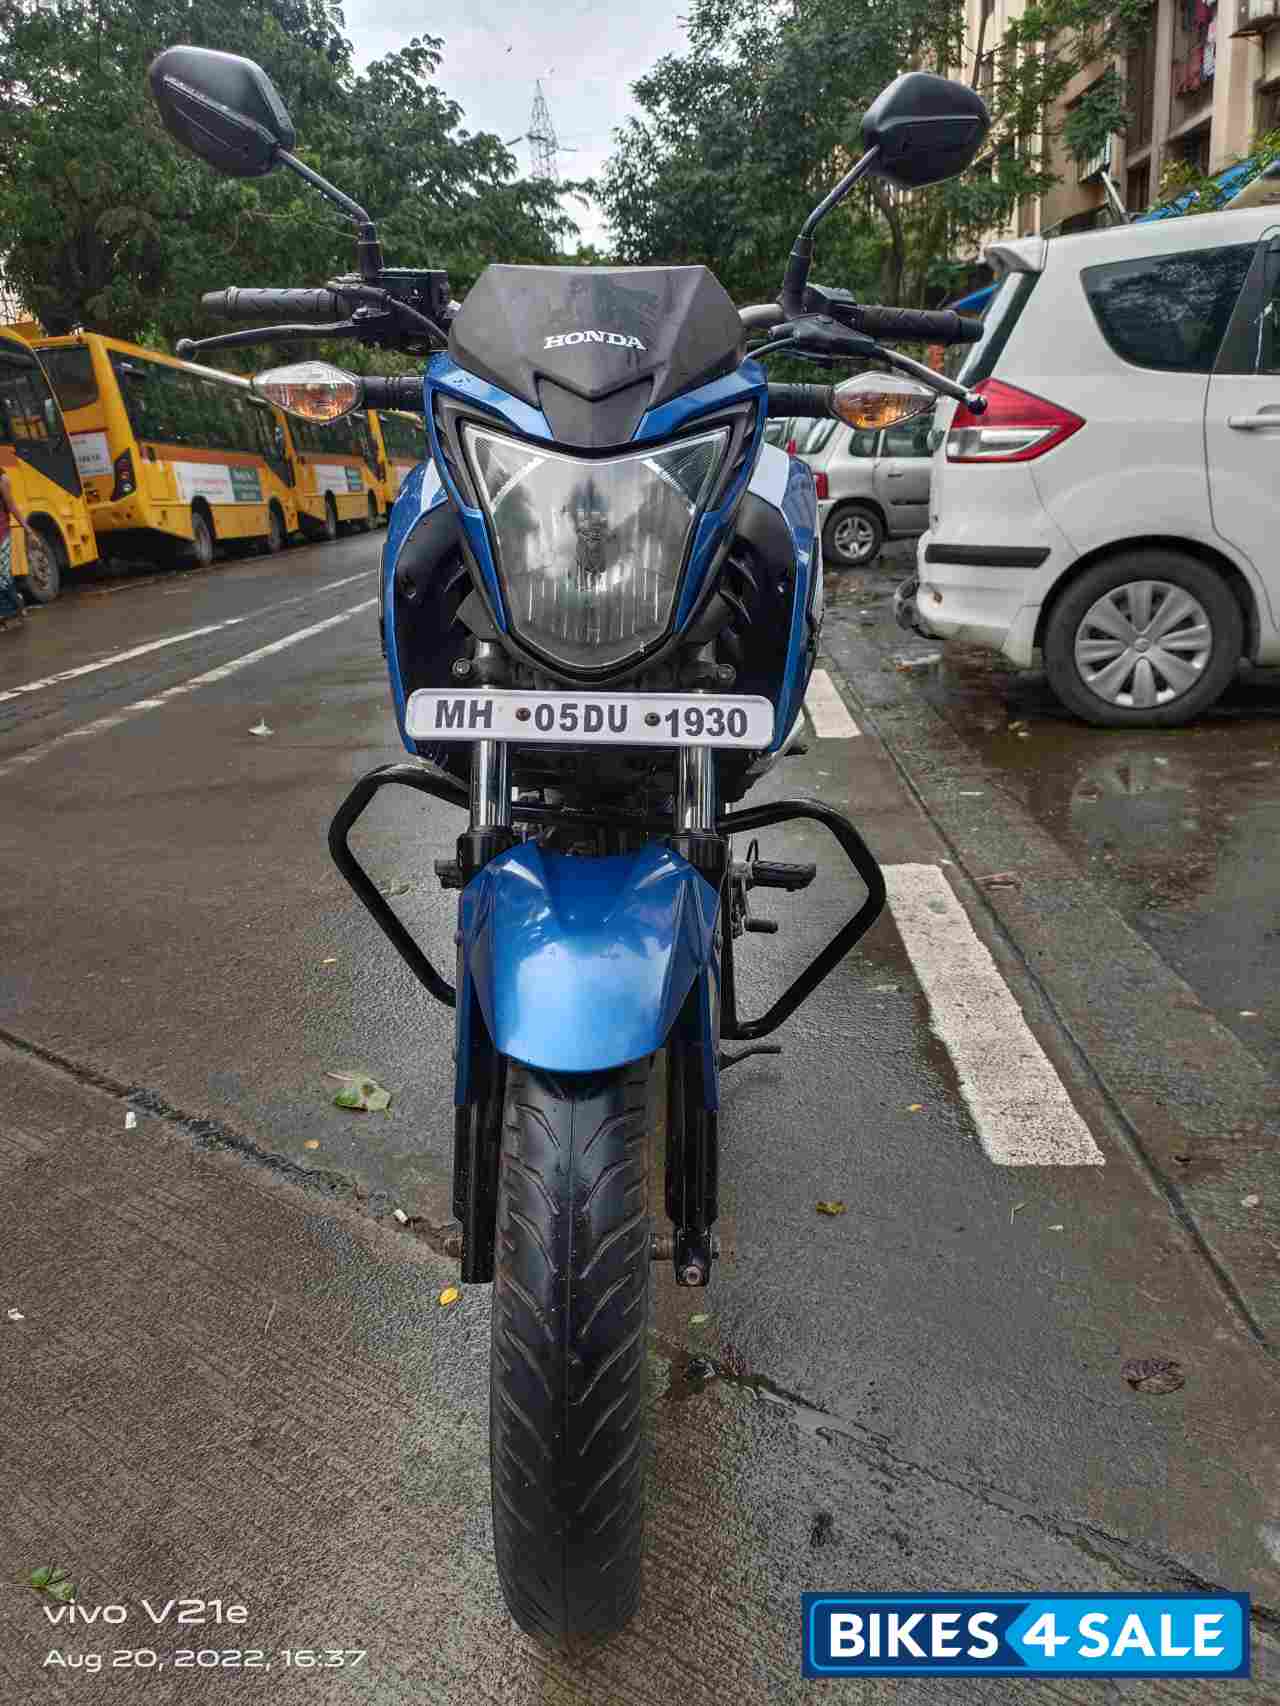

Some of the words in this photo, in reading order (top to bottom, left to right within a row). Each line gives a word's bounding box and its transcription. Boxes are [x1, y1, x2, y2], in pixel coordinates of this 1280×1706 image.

[543, 329, 648, 350] HONDA
[434, 699, 493, 729] MH
[534, 703, 628, 733] 05DU
[664, 707, 748, 737] 1930
